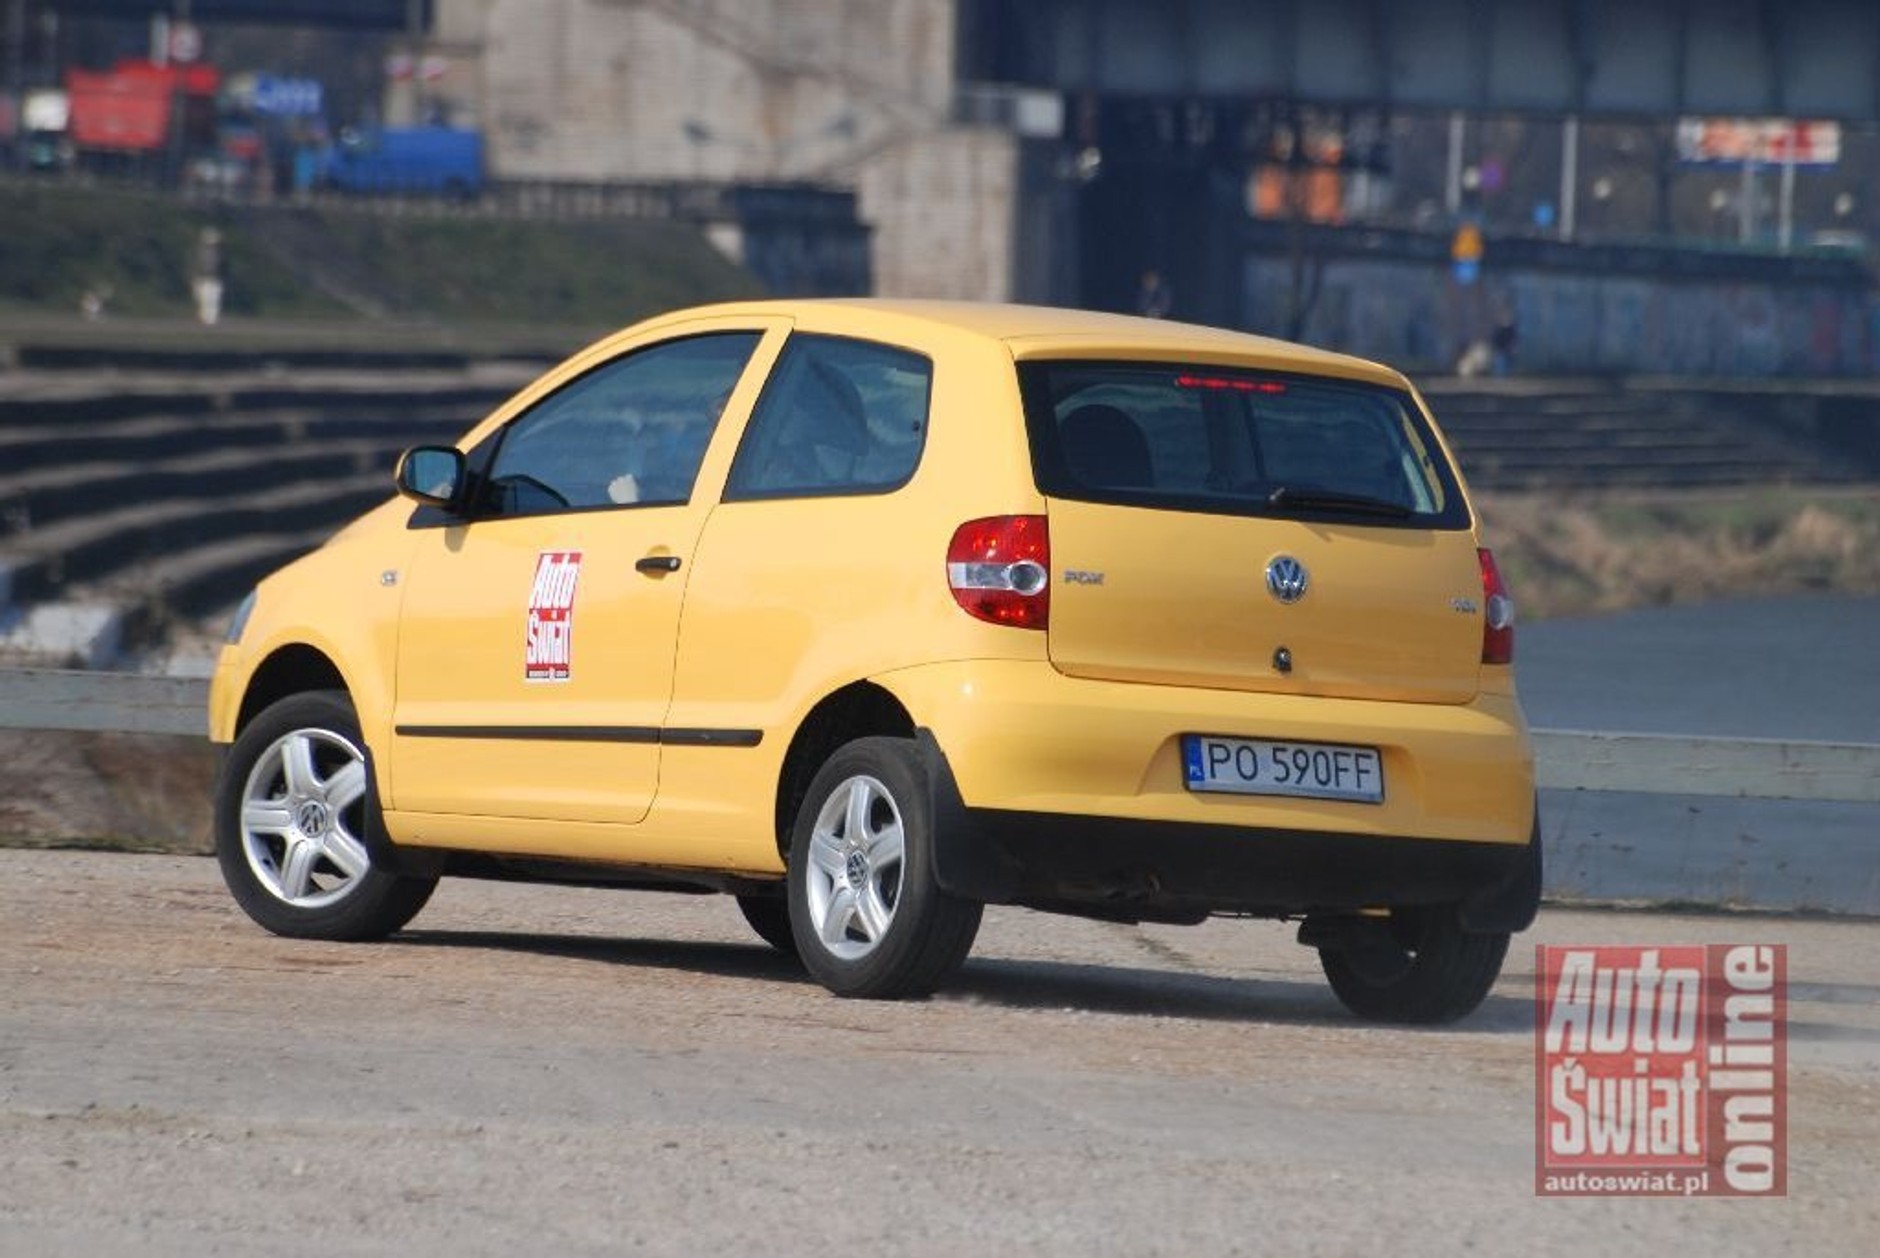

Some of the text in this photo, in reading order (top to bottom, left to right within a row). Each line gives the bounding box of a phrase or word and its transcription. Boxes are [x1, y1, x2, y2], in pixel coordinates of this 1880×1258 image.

[529, 553, 578, 608] Auto
[1208, 743, 1374, 789] PO 590FF
